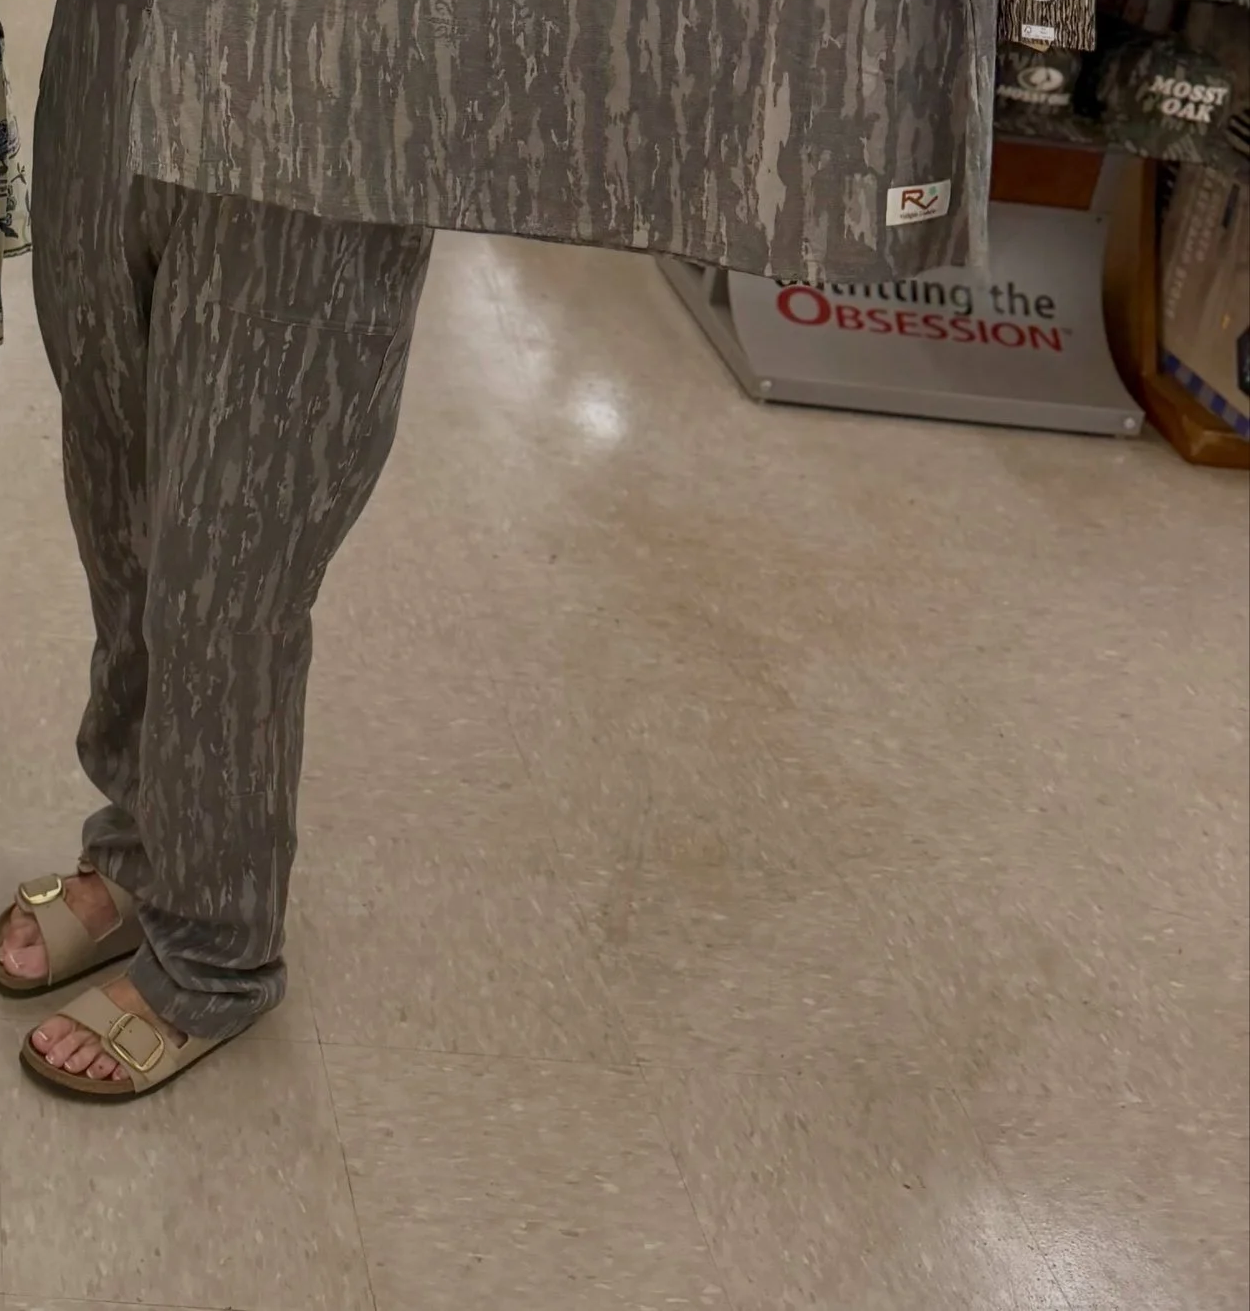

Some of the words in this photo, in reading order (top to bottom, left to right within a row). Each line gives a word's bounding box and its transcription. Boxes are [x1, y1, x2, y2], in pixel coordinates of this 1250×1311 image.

[1150, 75, 1228, 106] MOSSY
[1161, 98, 1214, 123] OAK
[990, 282, 1055, 319] the
[776, 286, 1064, 352] OBSESSION
